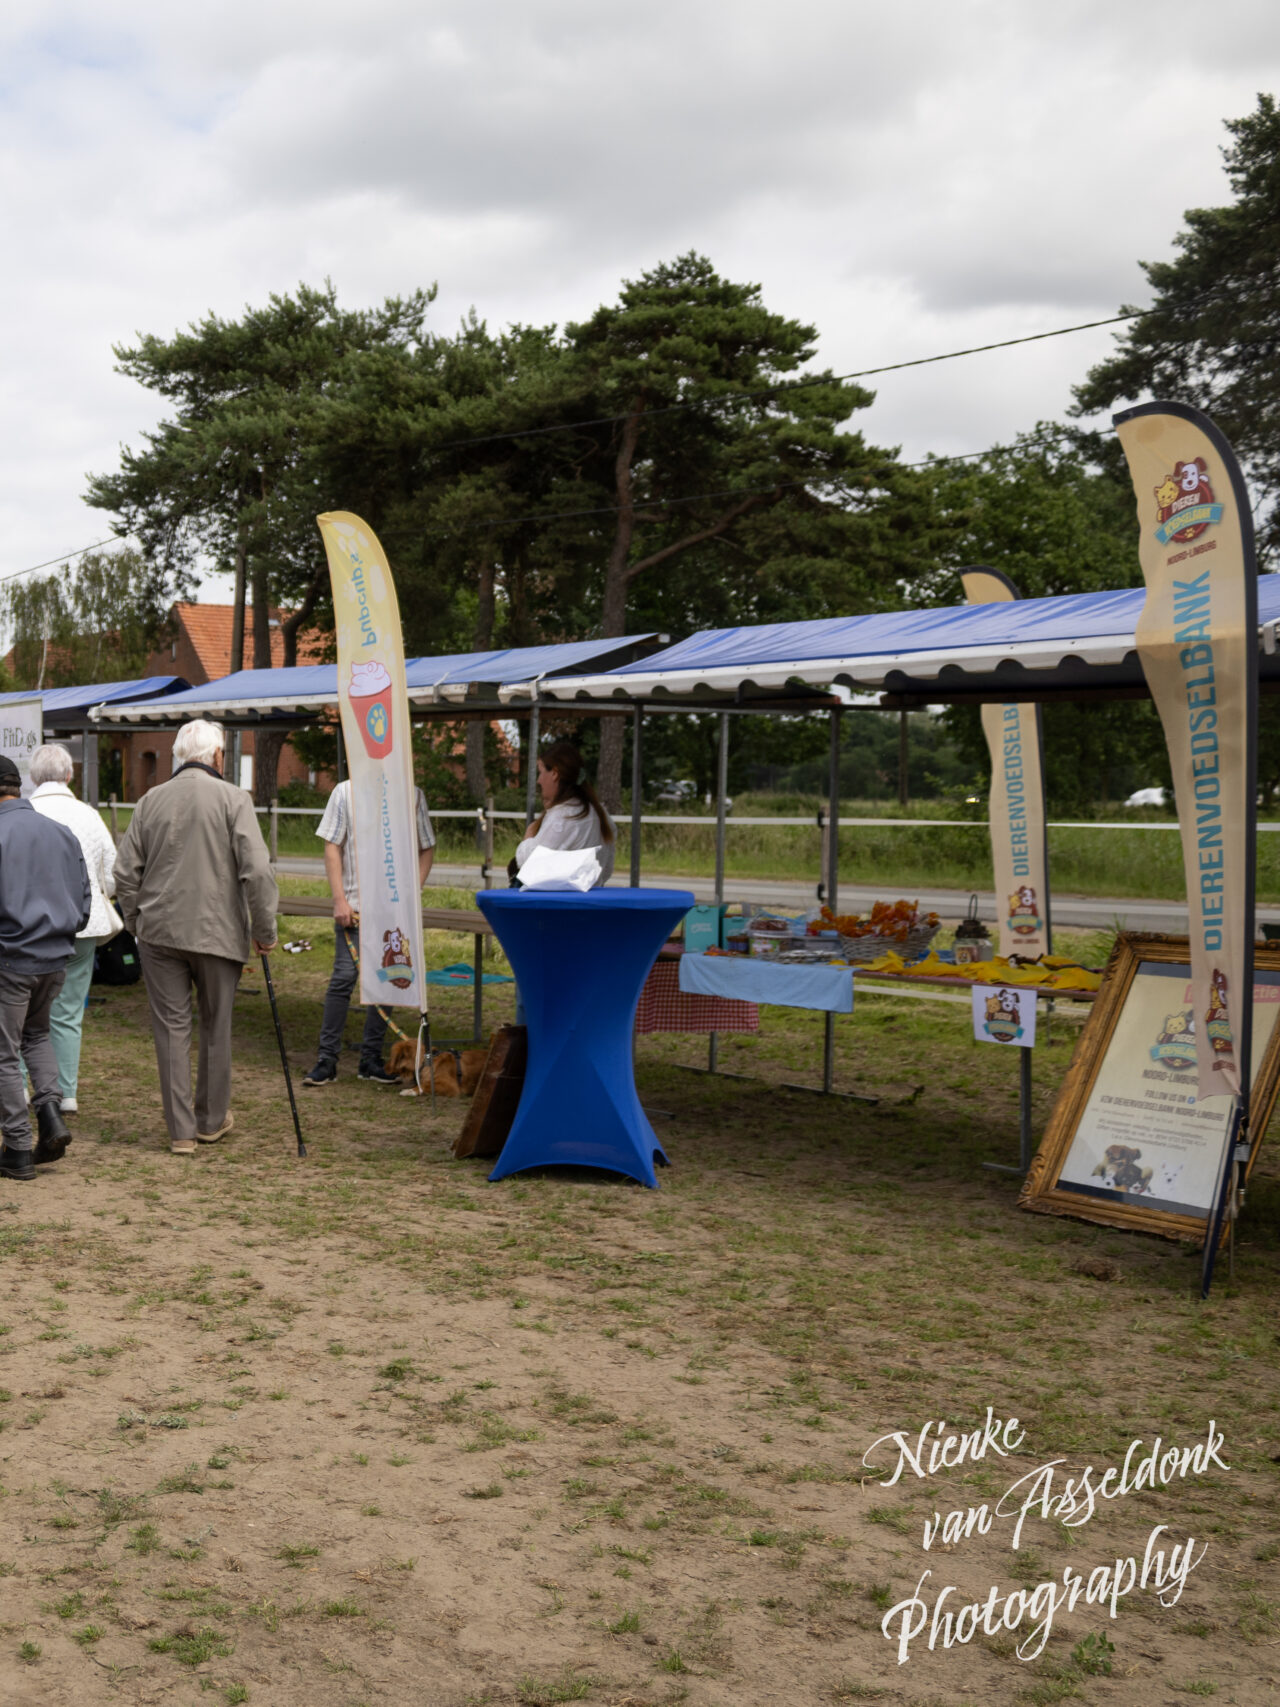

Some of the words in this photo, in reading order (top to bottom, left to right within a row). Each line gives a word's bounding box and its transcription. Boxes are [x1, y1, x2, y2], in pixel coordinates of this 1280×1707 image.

[3, 727, 37, 753] FitDgs
[1002, 703, 1030, 877] DIERENVOEDSELB
[1173, 570, 1224, 951] DIERENVOEDSELBANK
